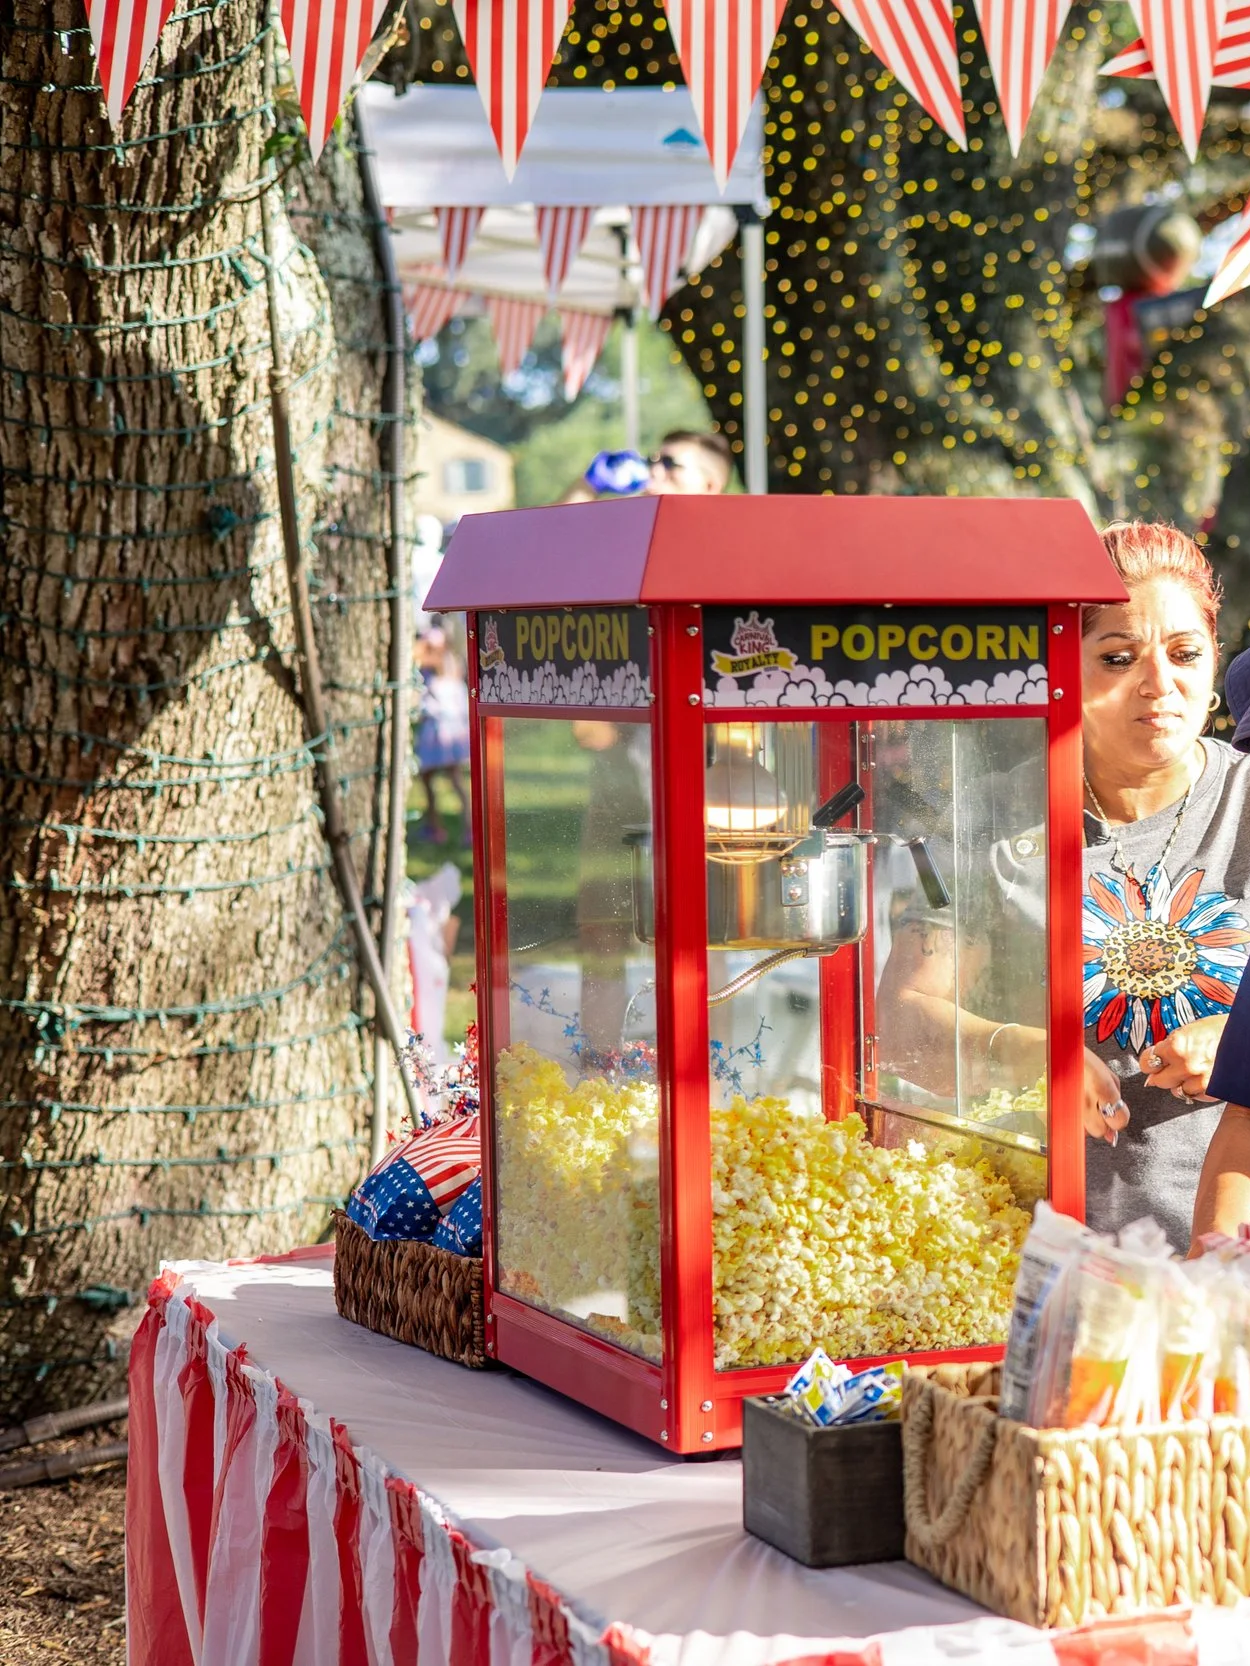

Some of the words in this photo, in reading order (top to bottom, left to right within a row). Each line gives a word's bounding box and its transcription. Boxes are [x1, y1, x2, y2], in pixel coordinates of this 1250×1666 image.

[516, 613, 629, 660] POPCORN
[734, 631, 775, 646] CARNIVAL
[811, 624, 1039, 660] POPCORN
[740, 641, 770, 654] KING
[731, 652, 779, 673] ROYALTY
